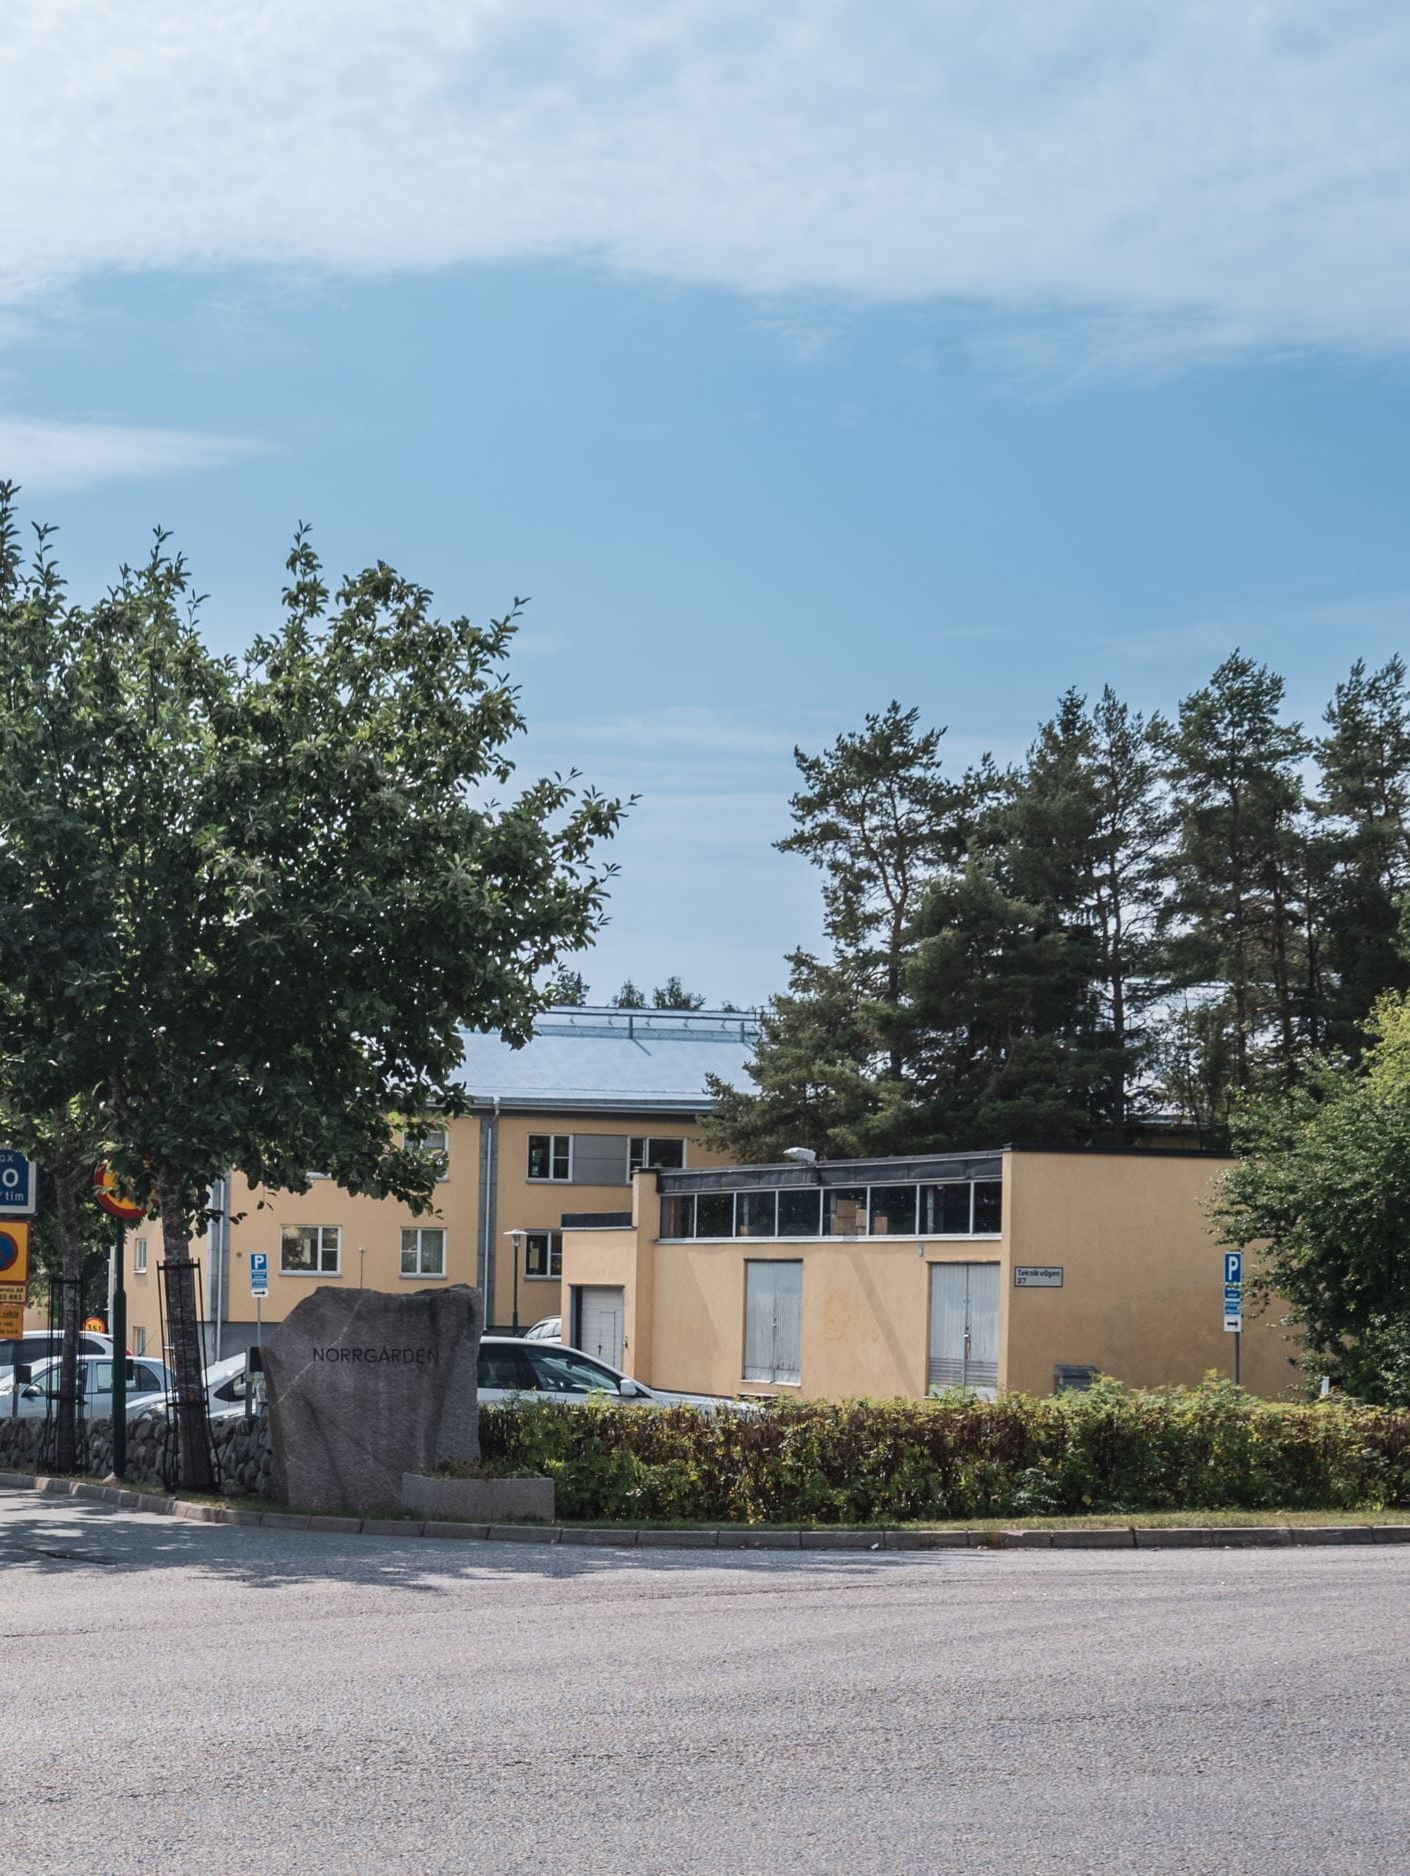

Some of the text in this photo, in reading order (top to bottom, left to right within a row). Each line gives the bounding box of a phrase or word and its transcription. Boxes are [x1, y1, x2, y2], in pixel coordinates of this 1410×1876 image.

[254, 1255, 265, 1269] P
[1228, 1256, 1239, 1280] P
[313, 1346, 439, 1363] NORRGÅRDEN
